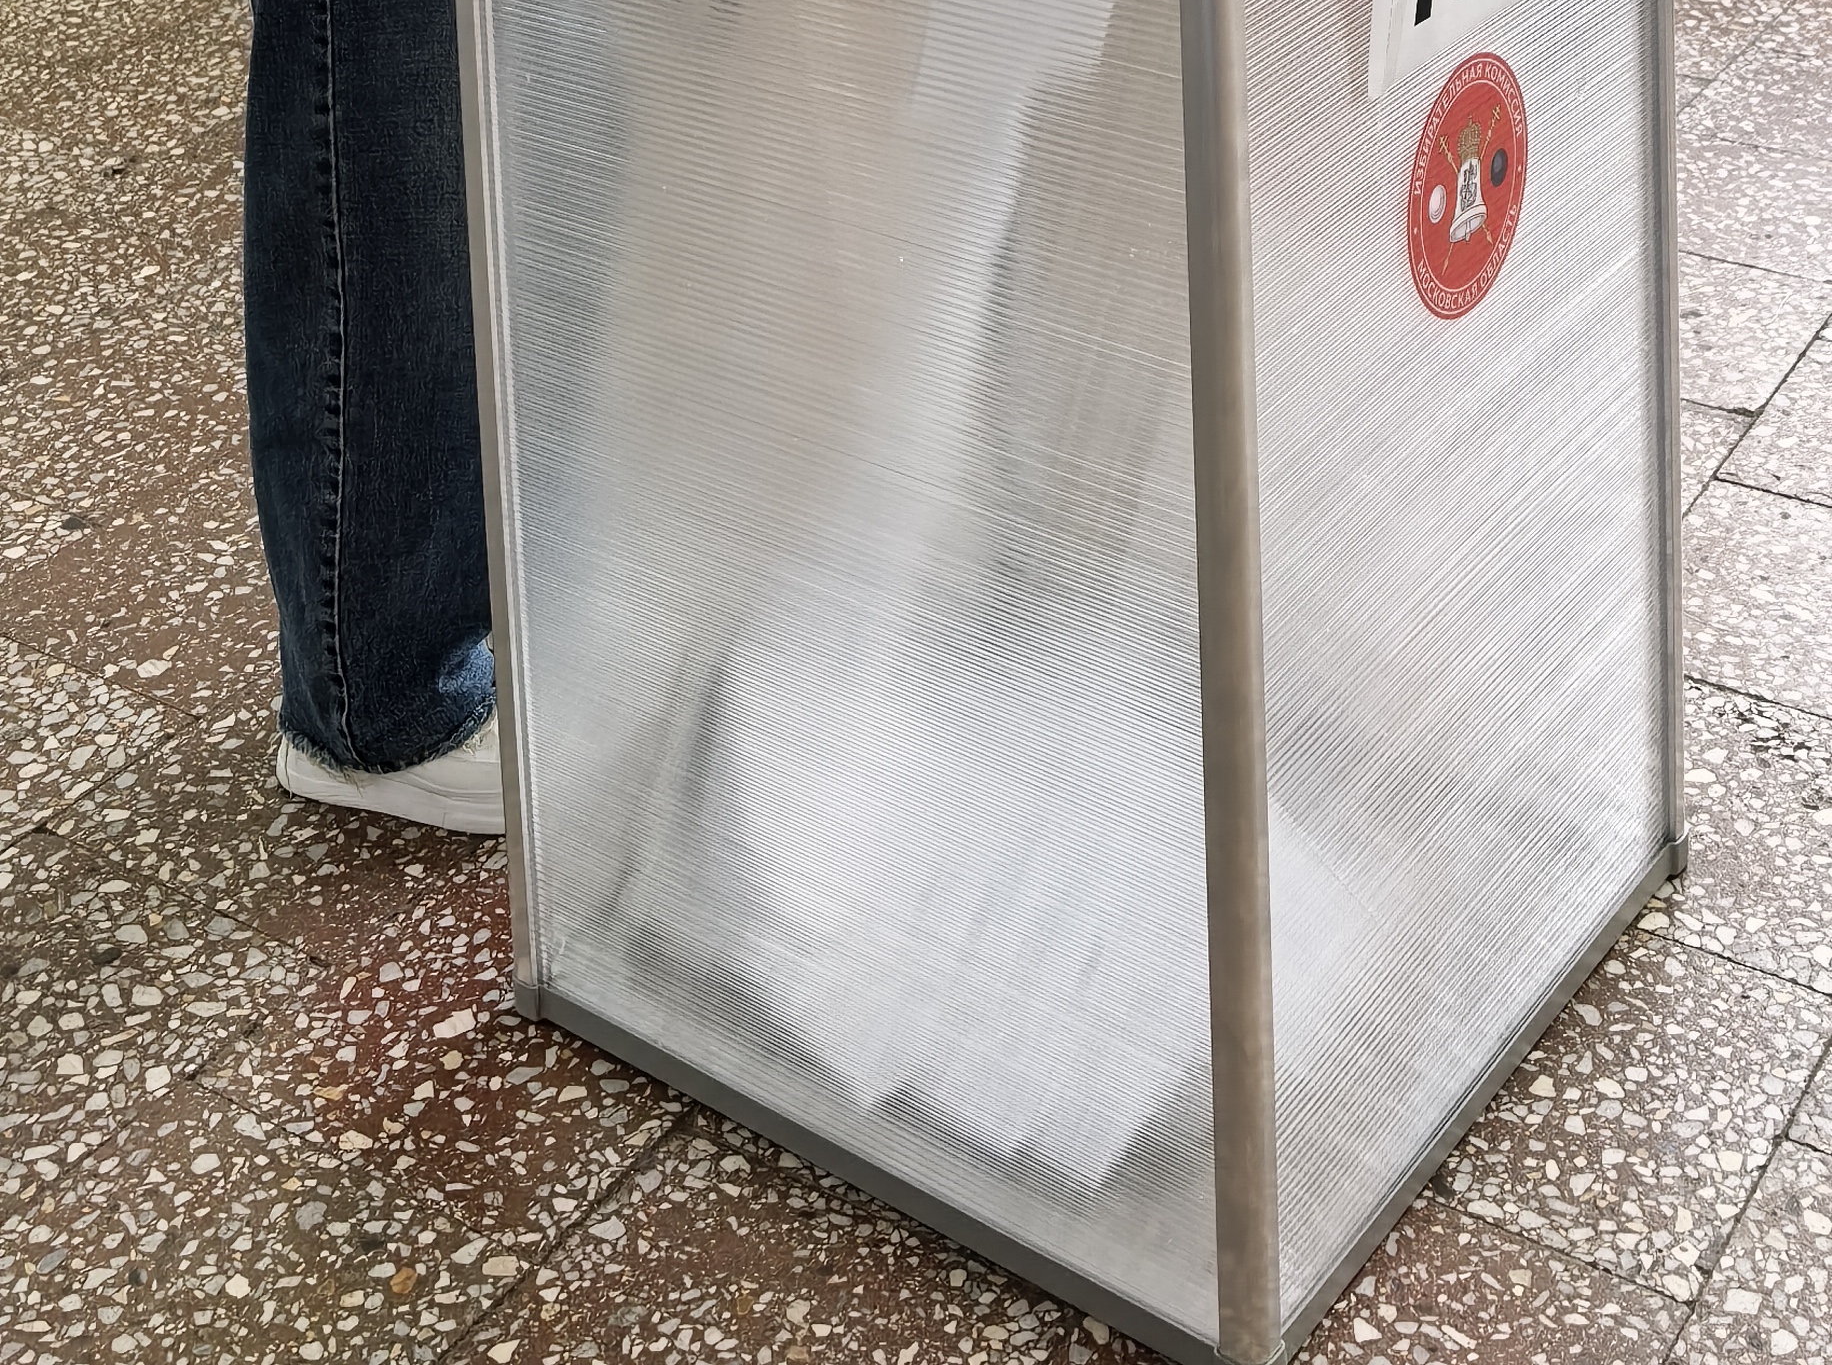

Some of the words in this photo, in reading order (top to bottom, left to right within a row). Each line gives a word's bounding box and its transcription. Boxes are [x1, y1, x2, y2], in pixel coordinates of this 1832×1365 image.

[1413, 62, 1483, 196] ИЗБИРАТЕЛЬНАЯ
[1483, 63, 1522, 137] КОМИССИЯ
[1417, 260, 1479, 310] МОСКОВСКАЯ
[1479, 203, 1518, 289] ОБЛАСТЬ
